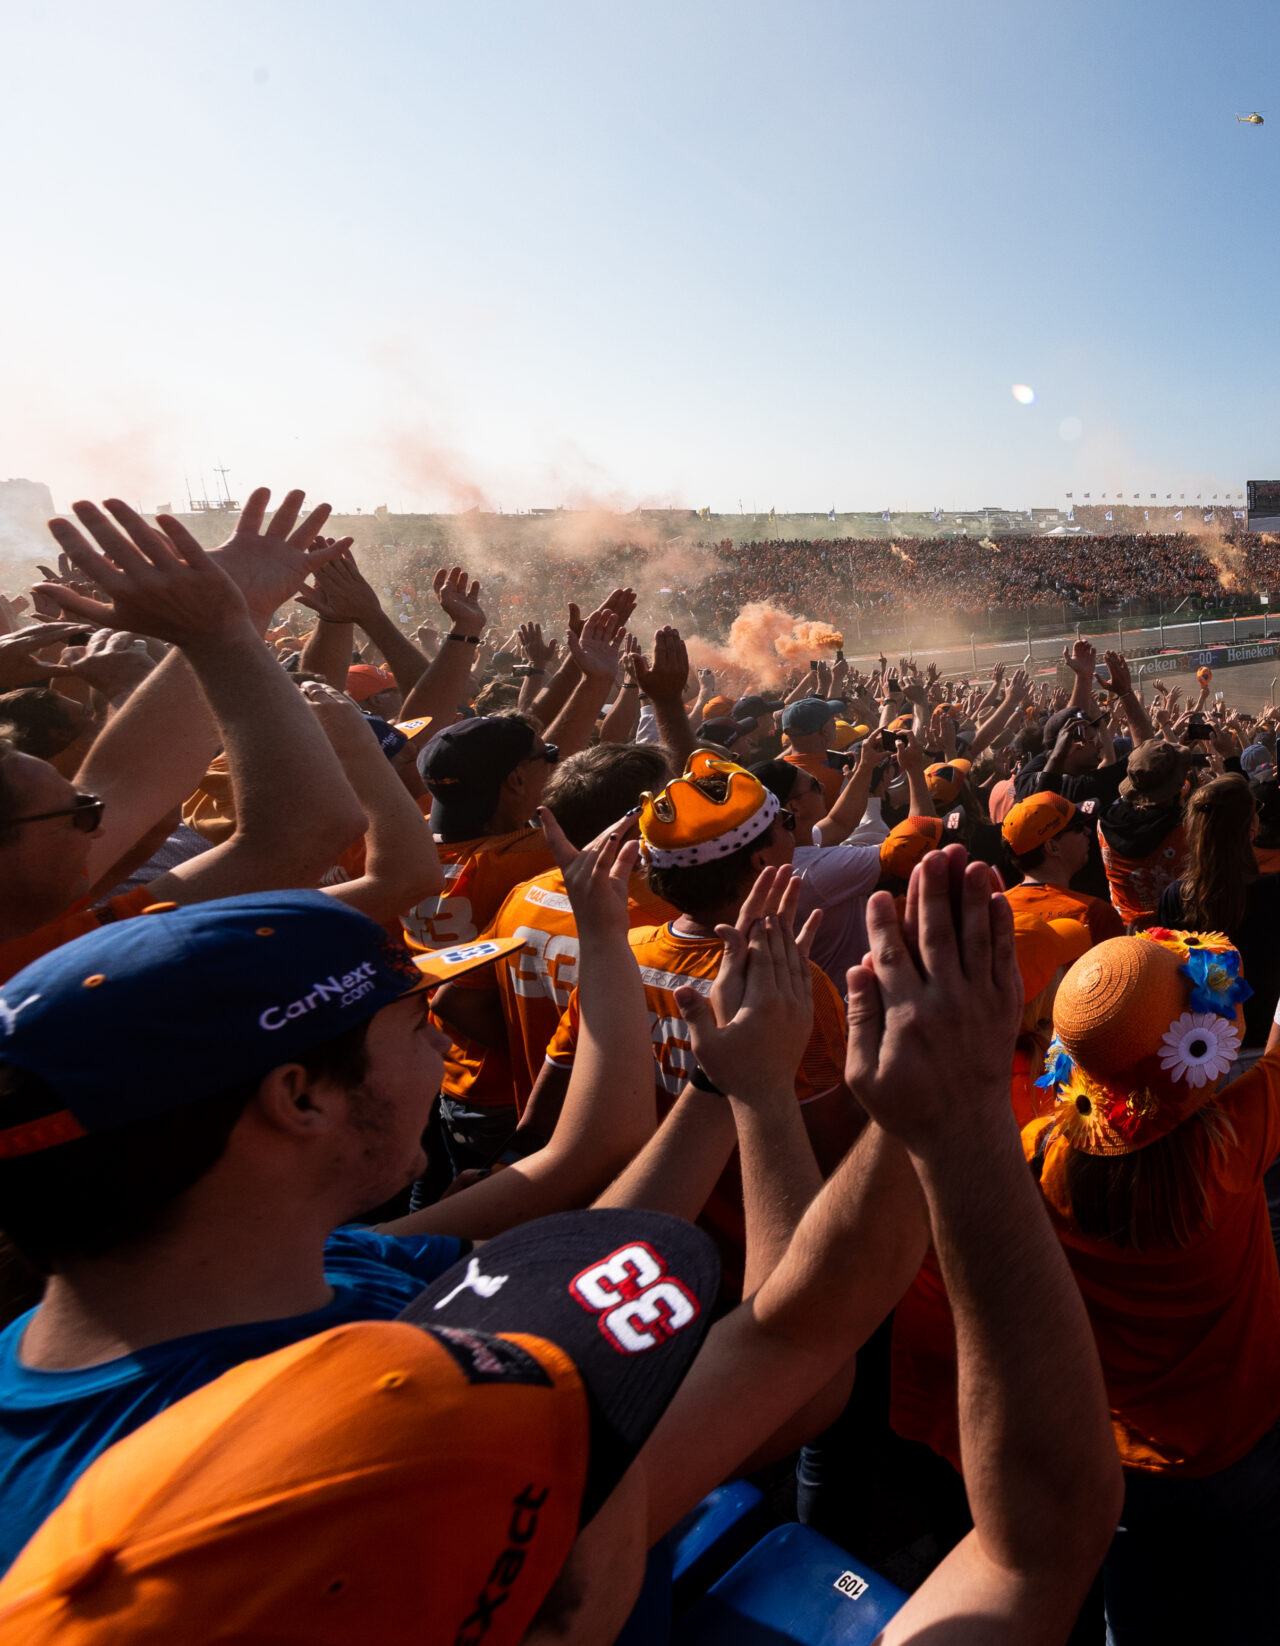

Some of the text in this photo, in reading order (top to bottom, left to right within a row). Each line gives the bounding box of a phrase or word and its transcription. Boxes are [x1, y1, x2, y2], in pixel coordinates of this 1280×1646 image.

[1129, 658, 1177, 675] eineken
[1227, 645, 1274, 662] Heineken
[258, 961, 377, 1031] CarNext
[507, 925, 580, 1006] 33
[568, 1240, 701, 1357] 33
